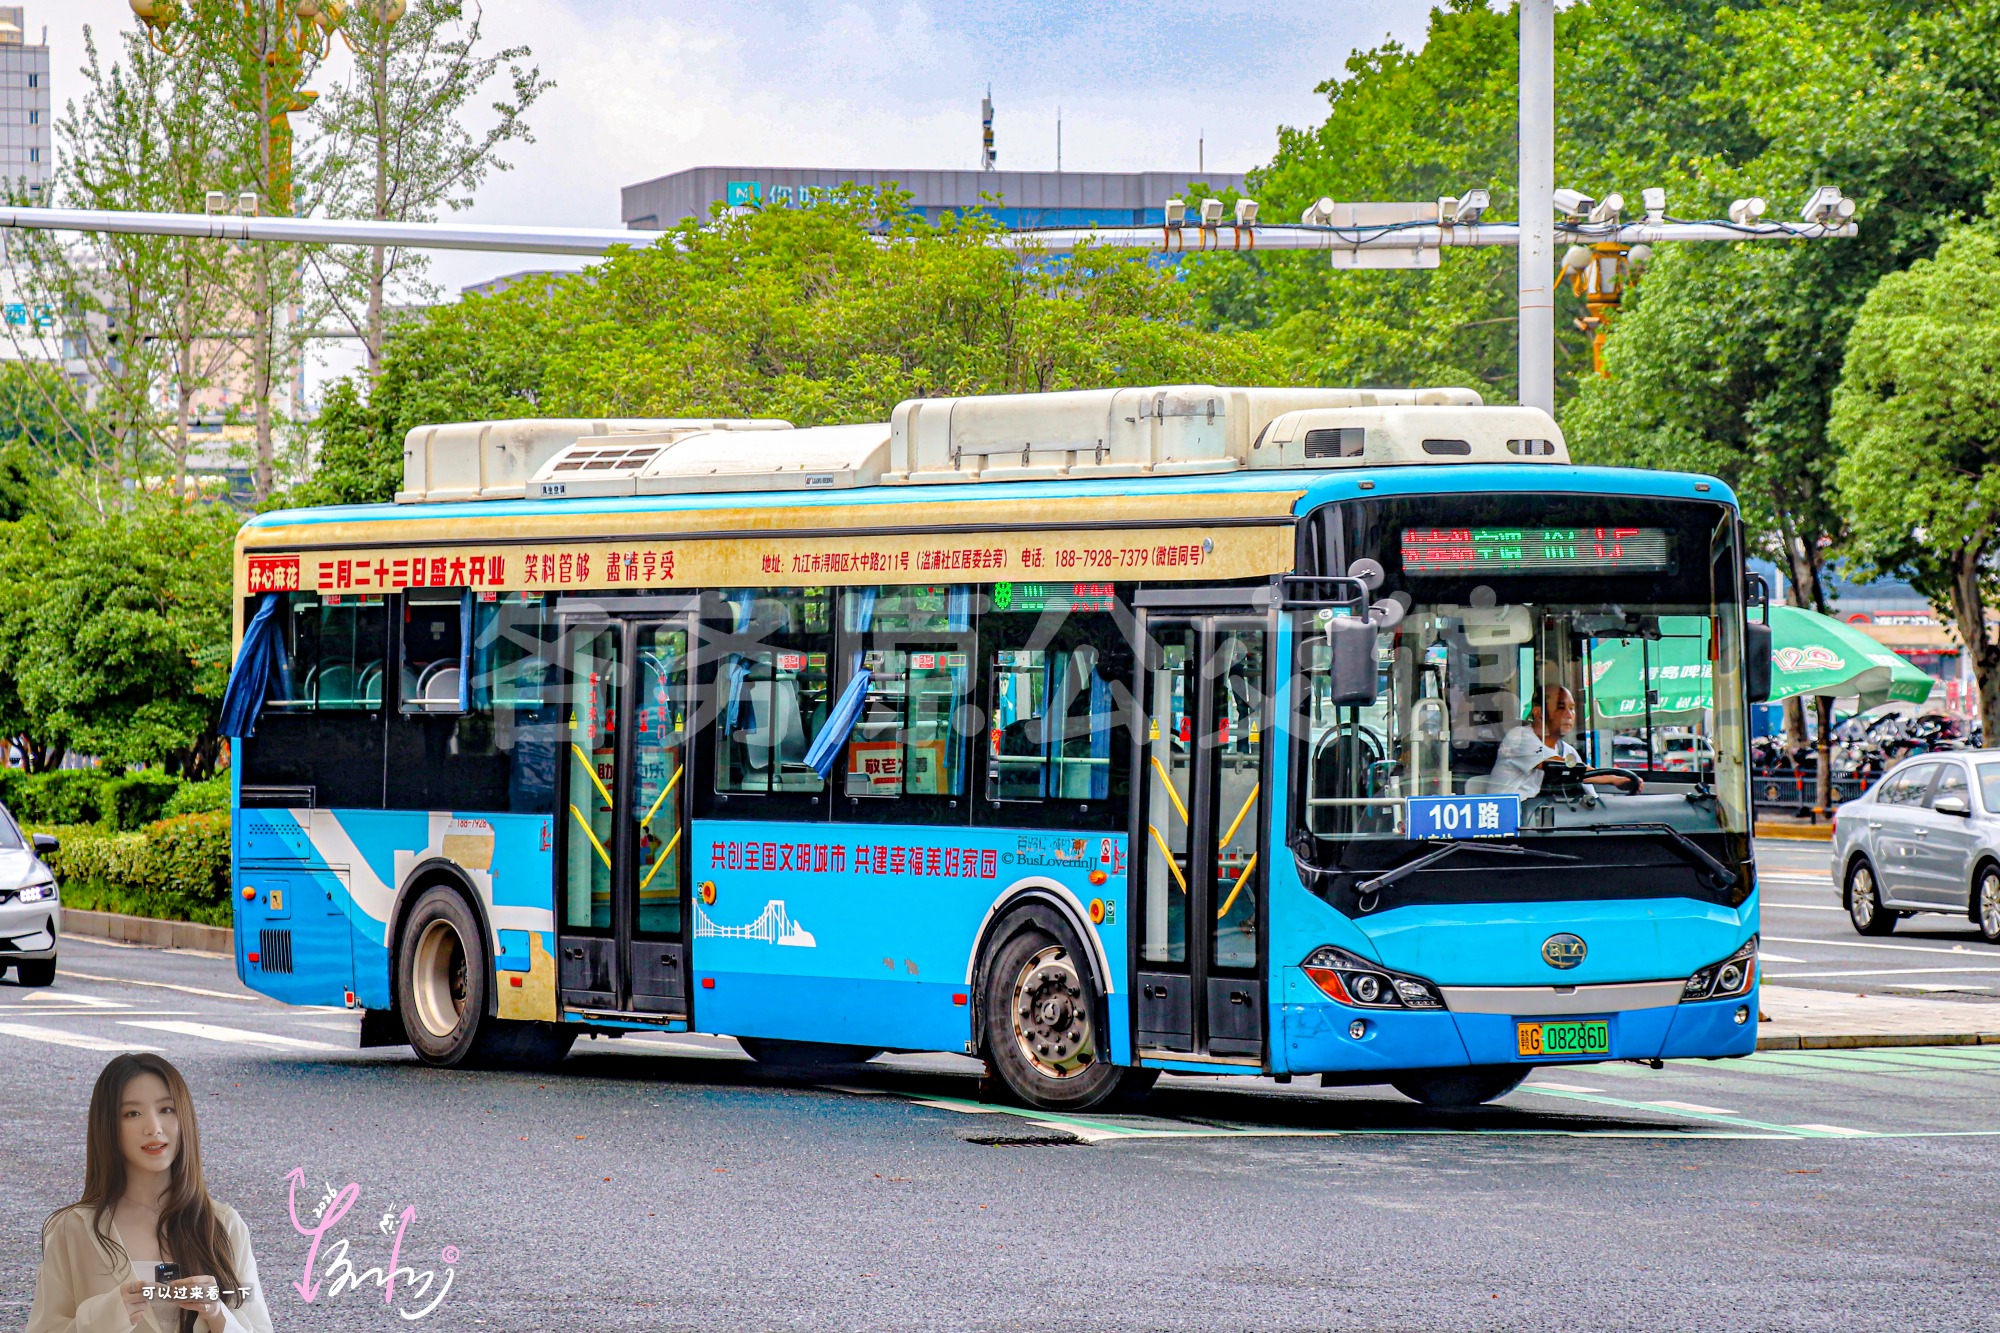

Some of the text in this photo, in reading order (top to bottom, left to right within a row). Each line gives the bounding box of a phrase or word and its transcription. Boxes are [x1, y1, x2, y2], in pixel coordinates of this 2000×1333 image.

[250, 566, 298, 590] 开心麻花
[318, 555, 505, 589] 三月二十三日盛大开业
[524, 552, 590, 584] 笑料管够
[711, 841, 846, 873] 共创全国文明城市
[854, 844, 997, 879] 共建幸福美好家园
